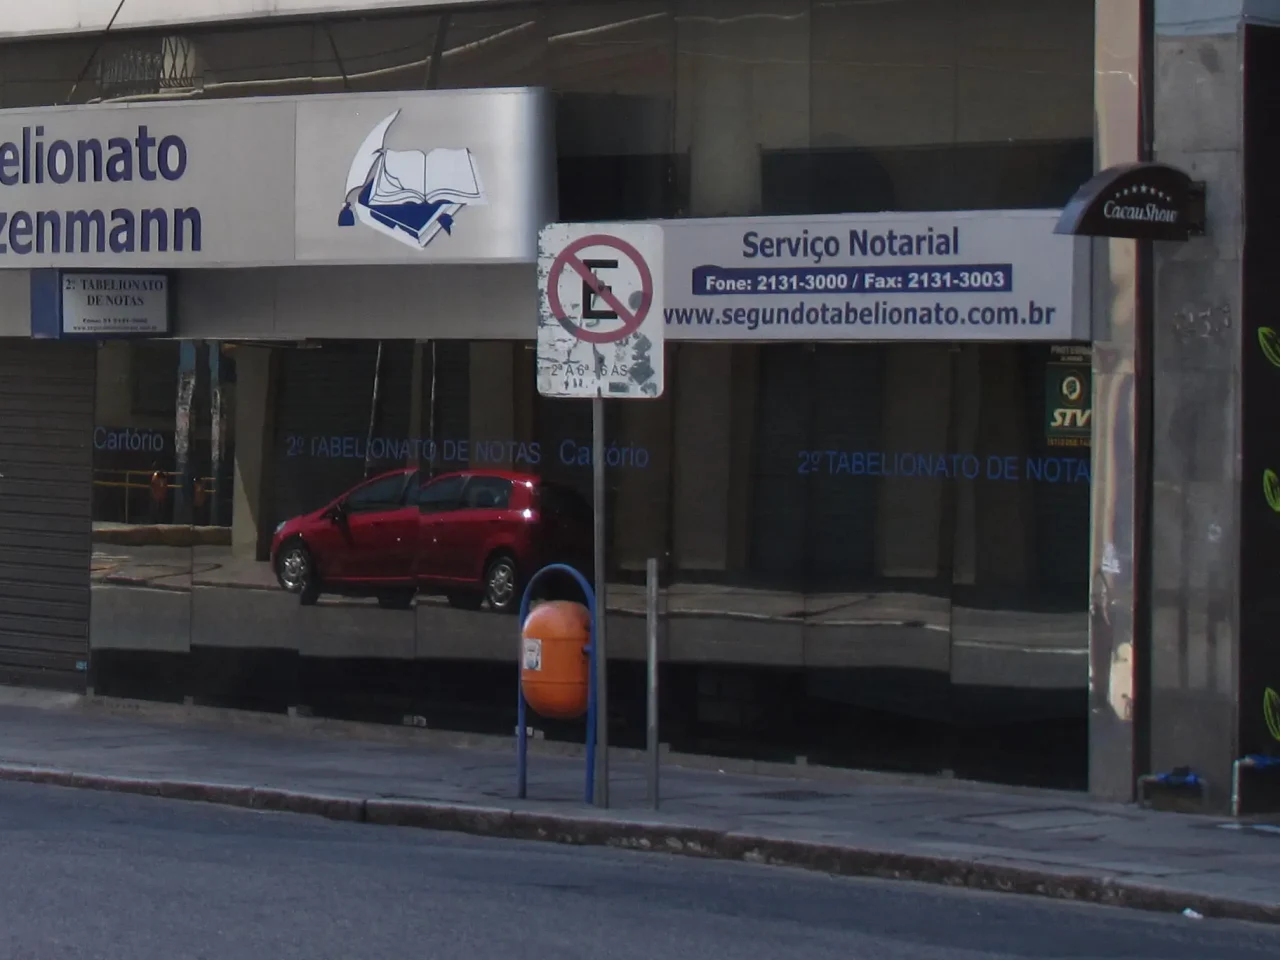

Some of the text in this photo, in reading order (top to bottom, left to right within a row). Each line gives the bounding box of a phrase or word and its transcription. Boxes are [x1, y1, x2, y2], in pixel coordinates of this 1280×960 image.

[742, 226, 959, 264] Serviço Notarial
[81, 278, 164, 291] TABELIONATO
[705, 271, 1004, 291] Fone: 2131-3000 / Fax: 2131-3003
[87, 294, 145, 306] DE NOTAS
[1050, 408, 1092, 427] STV
[93, 426, 164, 452] Cartório
[310, 436, 437, 459] TABELIONATO
[443, 439, 469, 461] DE
[475, 440, 542, 465] NOTAS
[560, 438, 650, 468] Caório
[825, 450, 980, 480] TABELIONATO
[987, 455, 1019, 481] DE
[1026, 456, 1091, 483] NOTA
